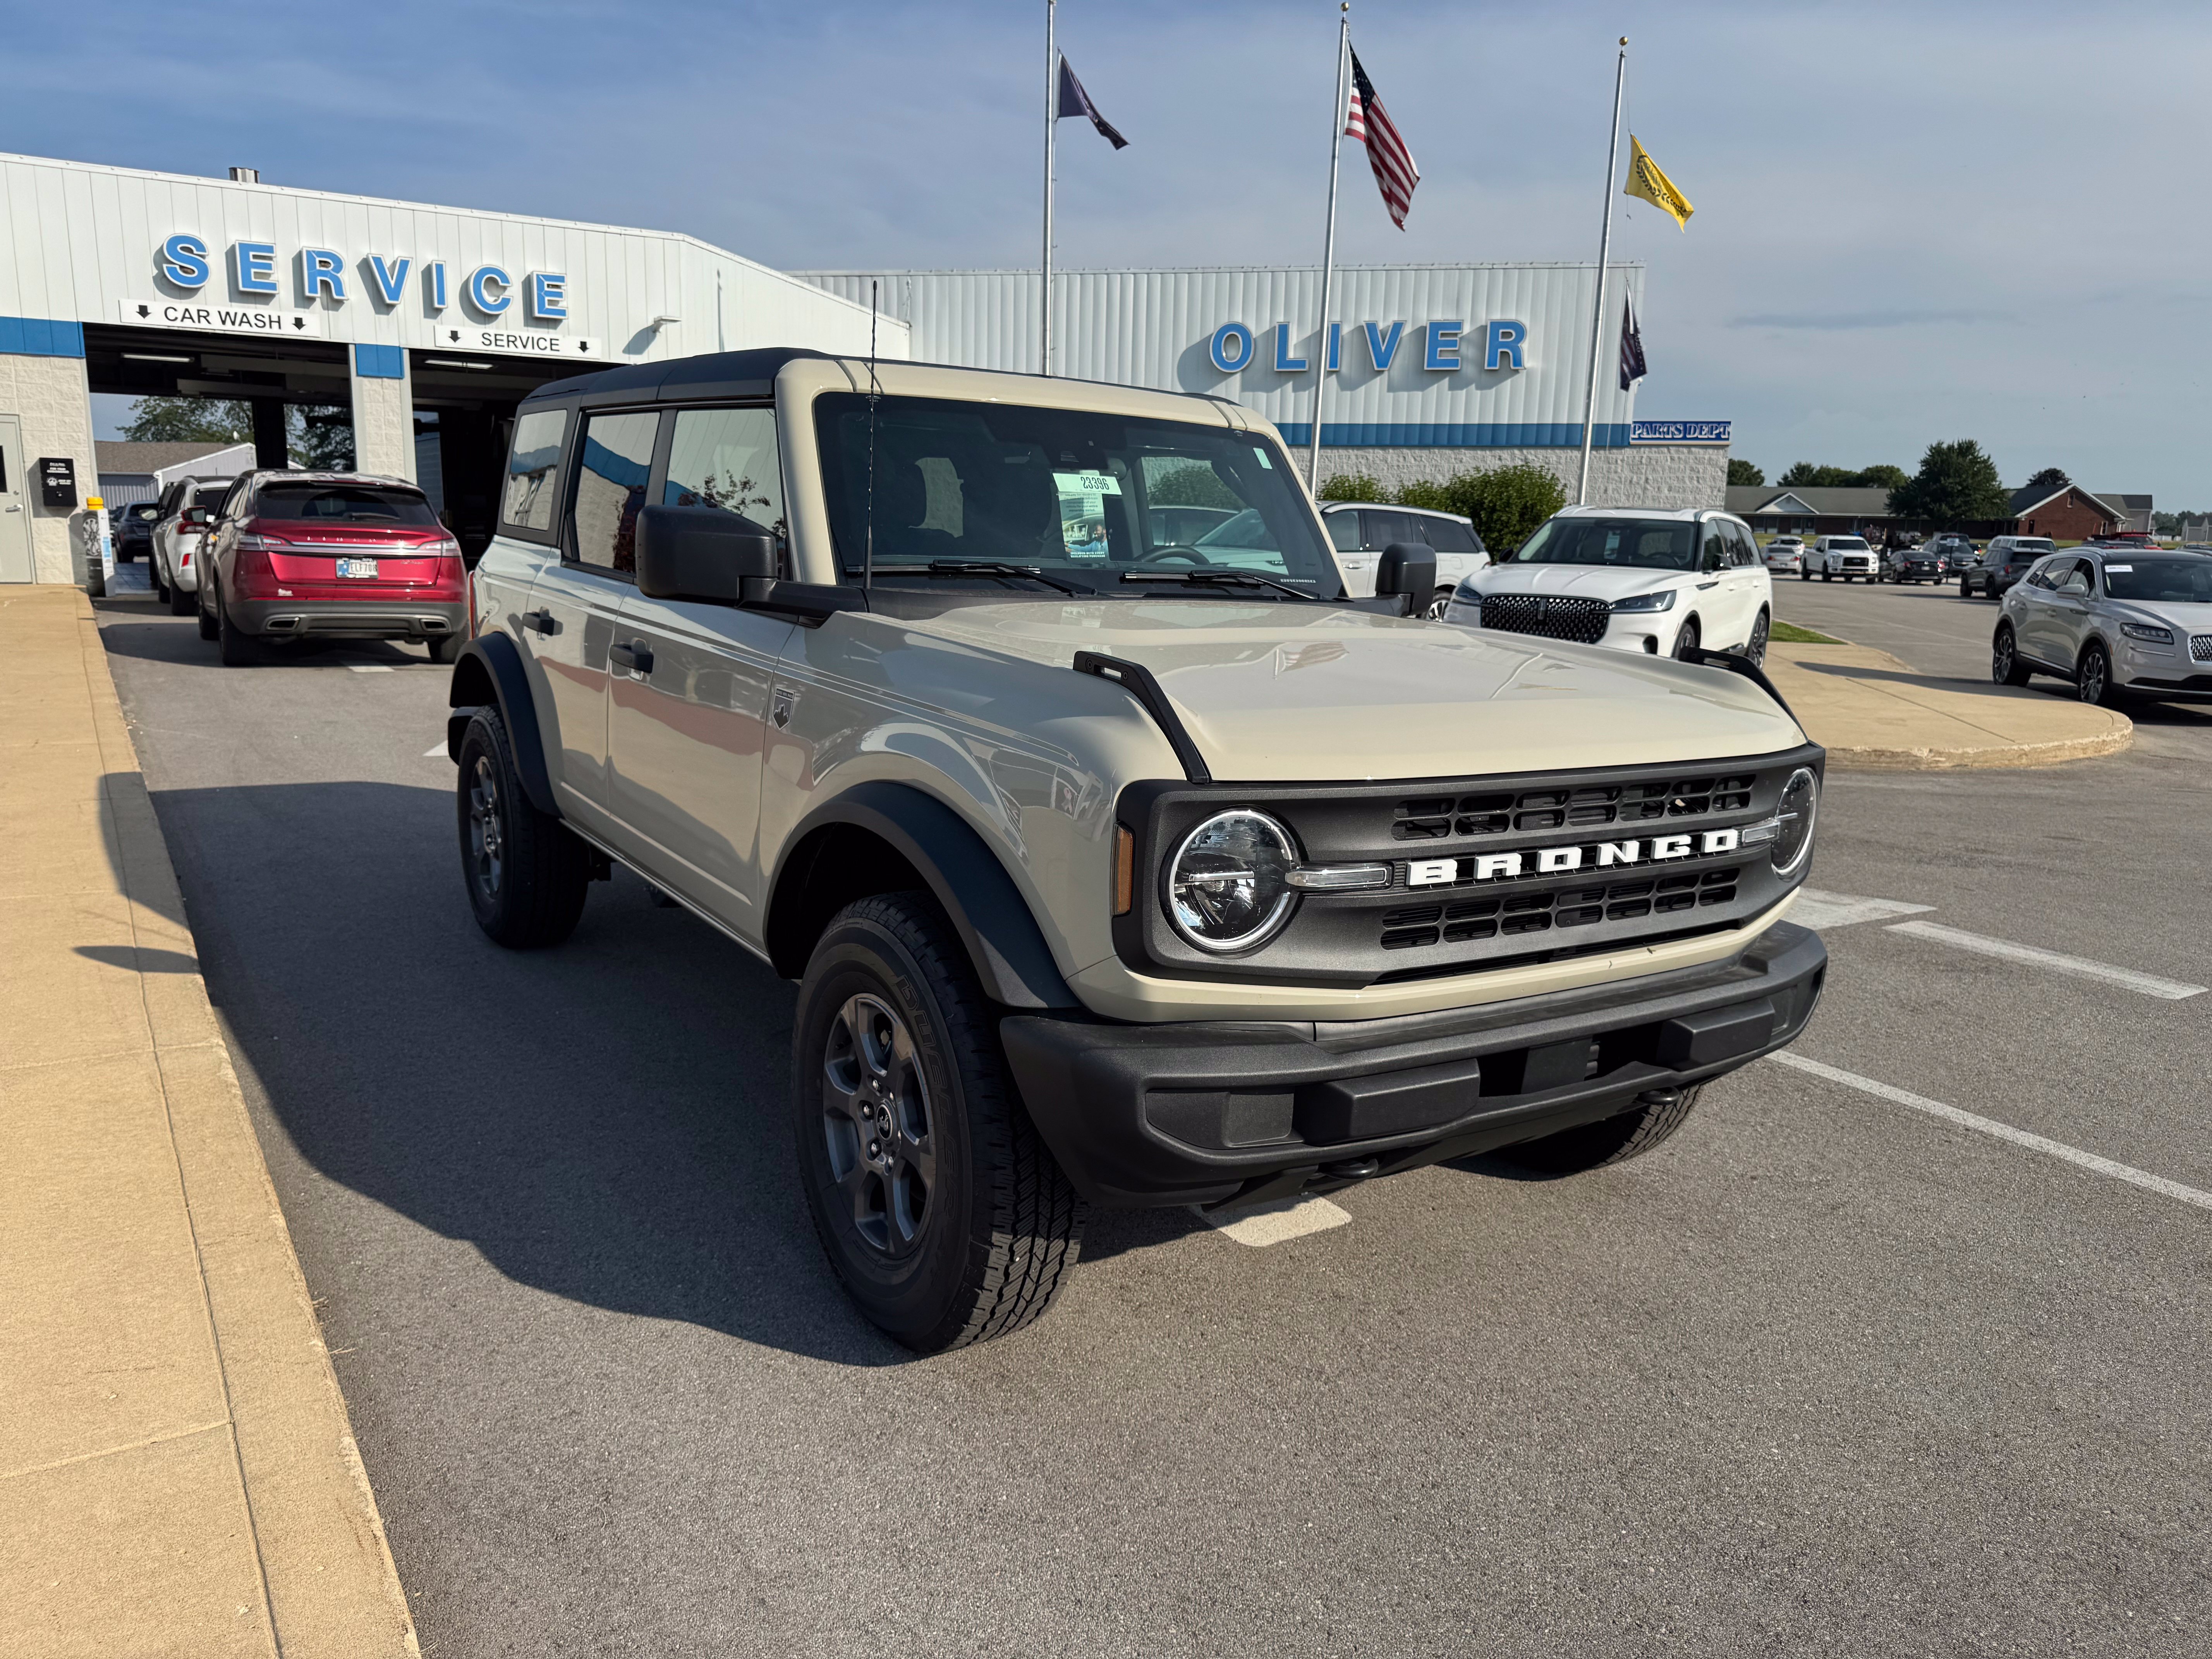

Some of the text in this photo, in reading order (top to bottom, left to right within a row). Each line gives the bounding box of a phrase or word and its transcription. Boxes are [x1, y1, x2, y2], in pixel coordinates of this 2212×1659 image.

[162, 234, 568, 320] SERVICE
[164, 307, 282, 330] CAR WASH
[481, 332, 560, 352] SERVICE
[1209, 319, 1527, 373] OLIVER
[1631, 424, 1731, 438] PARTS DEPT
[1080, 476, 1109, 490] 23396
[1405, 828, 1738, 886] BRONCO
[896, 975, 957, 1221] DUELER
